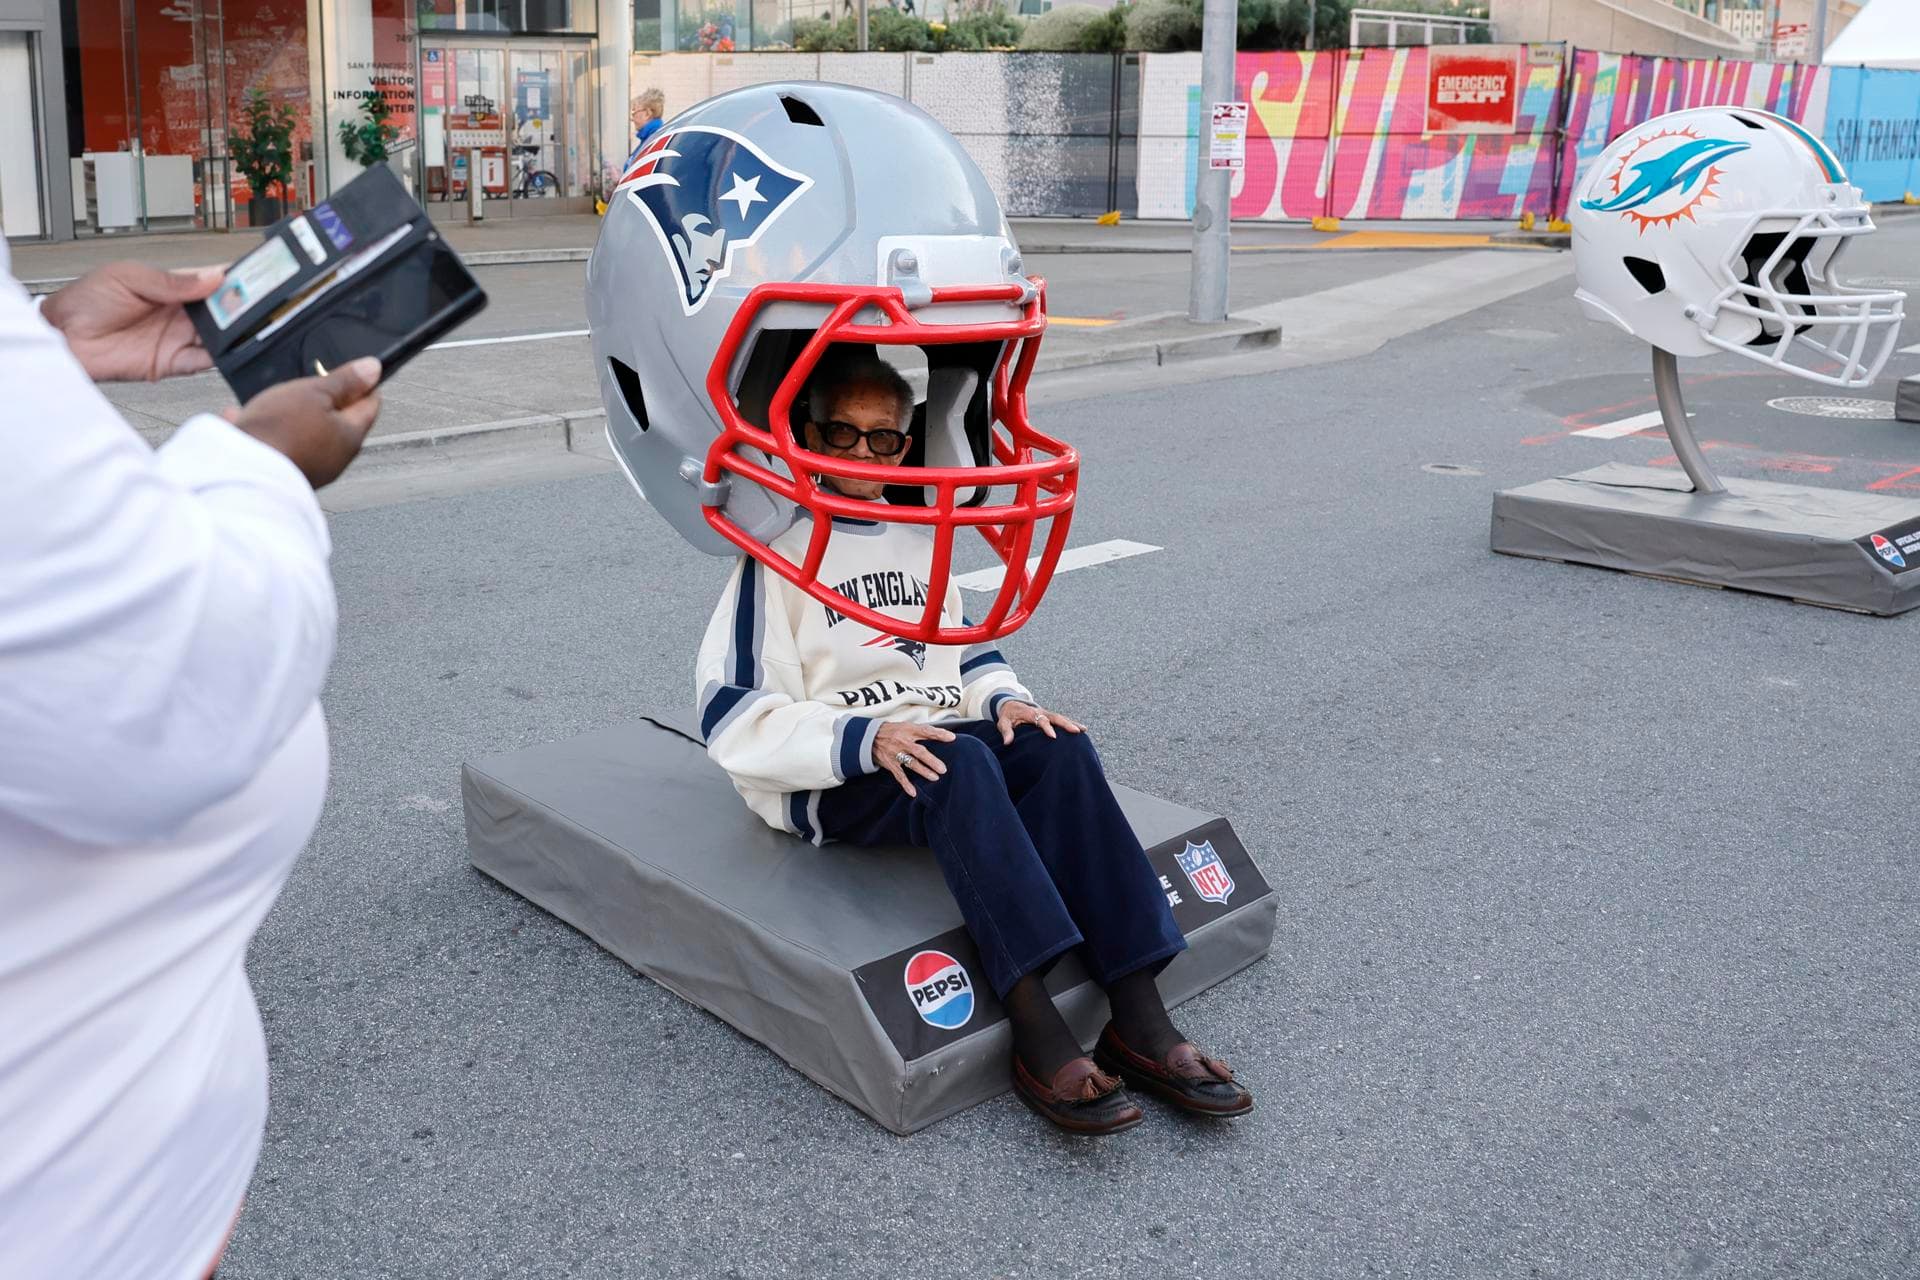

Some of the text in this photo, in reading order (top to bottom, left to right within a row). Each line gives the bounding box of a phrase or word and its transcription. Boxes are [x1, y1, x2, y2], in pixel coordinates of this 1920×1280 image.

[347, 62, 414, 70] SAN FRANCISCO
[368, 76, 414, 86] VISITOR
[1438, 75, 1507, 91] EMERGENCY
[333, 90, 415, 100] INFORMATION
[1437, 90, 1506, 104] EXIT
[371, 104, 415, 113] CENTER
[1837, 118, 1862, 162] SAN
[861, 571, 946, 613] ENGLA
[1192, 864, 1229, 896] NFL
[912, 971, 968, 1007] PEPSI
